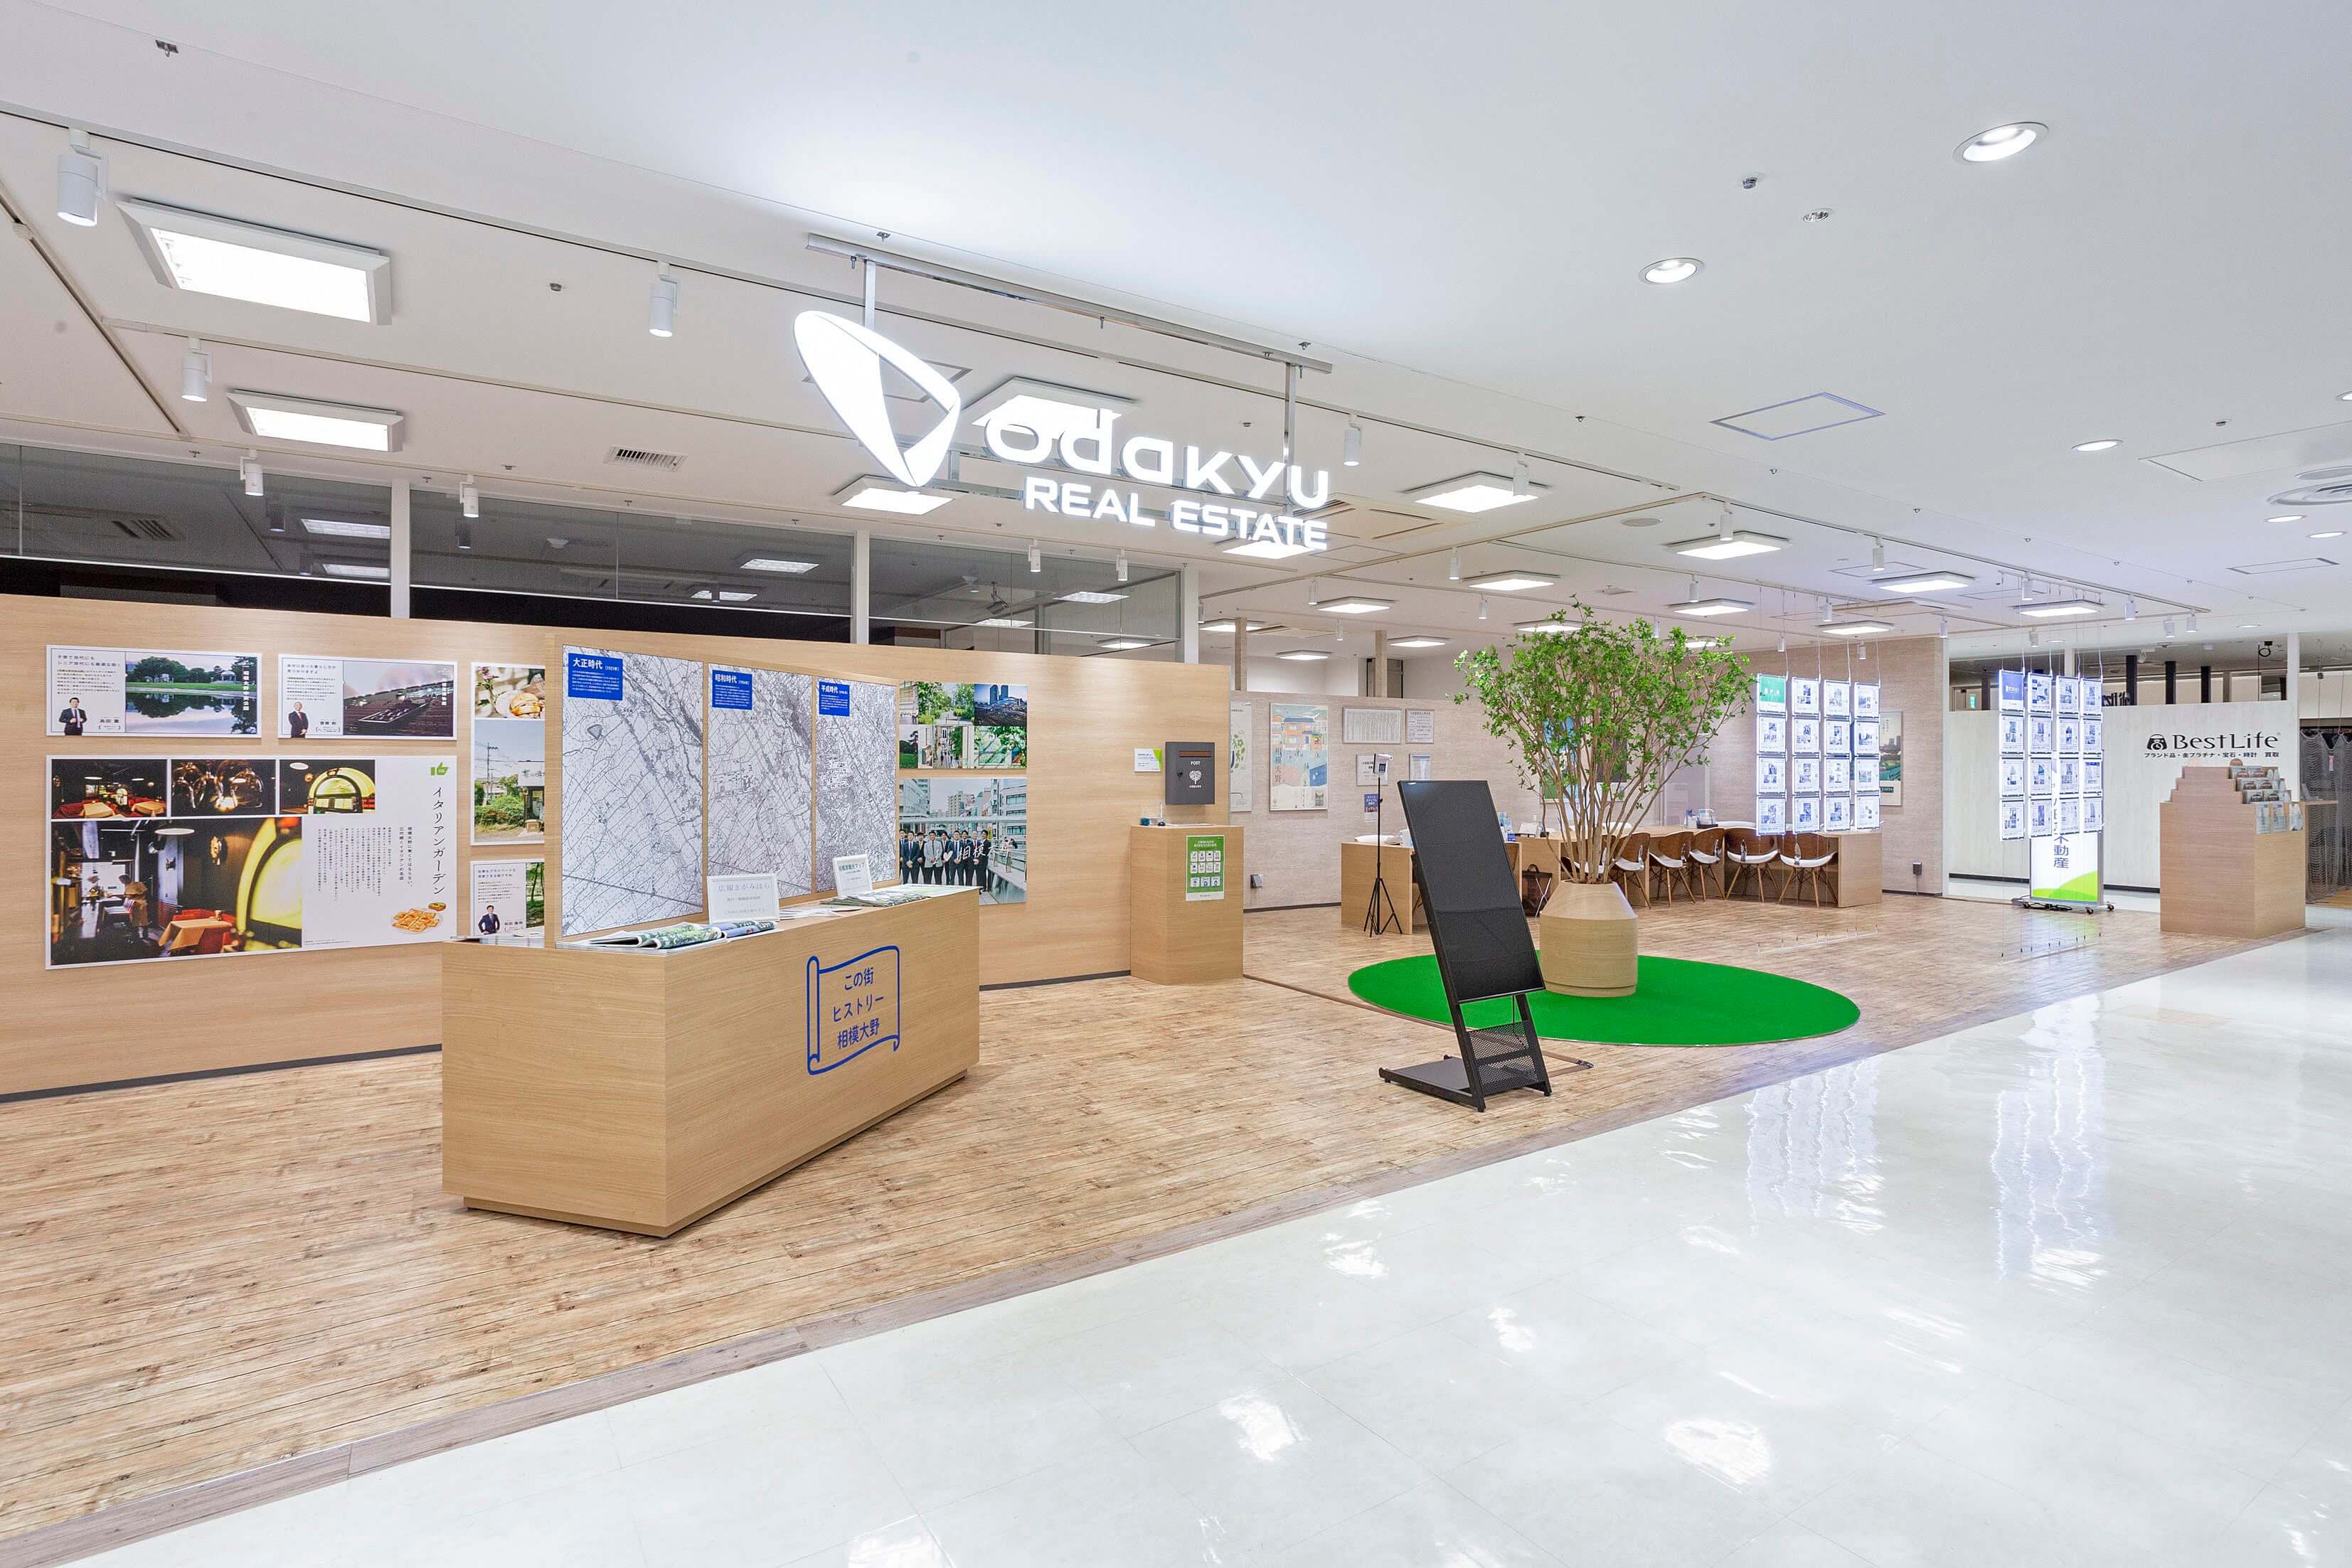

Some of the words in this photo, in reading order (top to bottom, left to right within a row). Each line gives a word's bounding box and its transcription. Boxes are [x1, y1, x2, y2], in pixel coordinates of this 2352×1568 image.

[983, 407, 1330, 510] odakyu
[1023, 476, 1156, 528] REAL
[1170, 499, 1329, 552] ESTATE
[573, 657, 603, 670] 大正時代
[715, 673, 738, 683] 昭和時代
[2172, 731, 2279, 750] BestLife
[432, 786, 445, 895] イタリアンガーデン
[844, 967, 874, 991] この街
[833, 993, 884, 1023] ヒストリー
[837, 1018, 880, 1050] 相模大野
